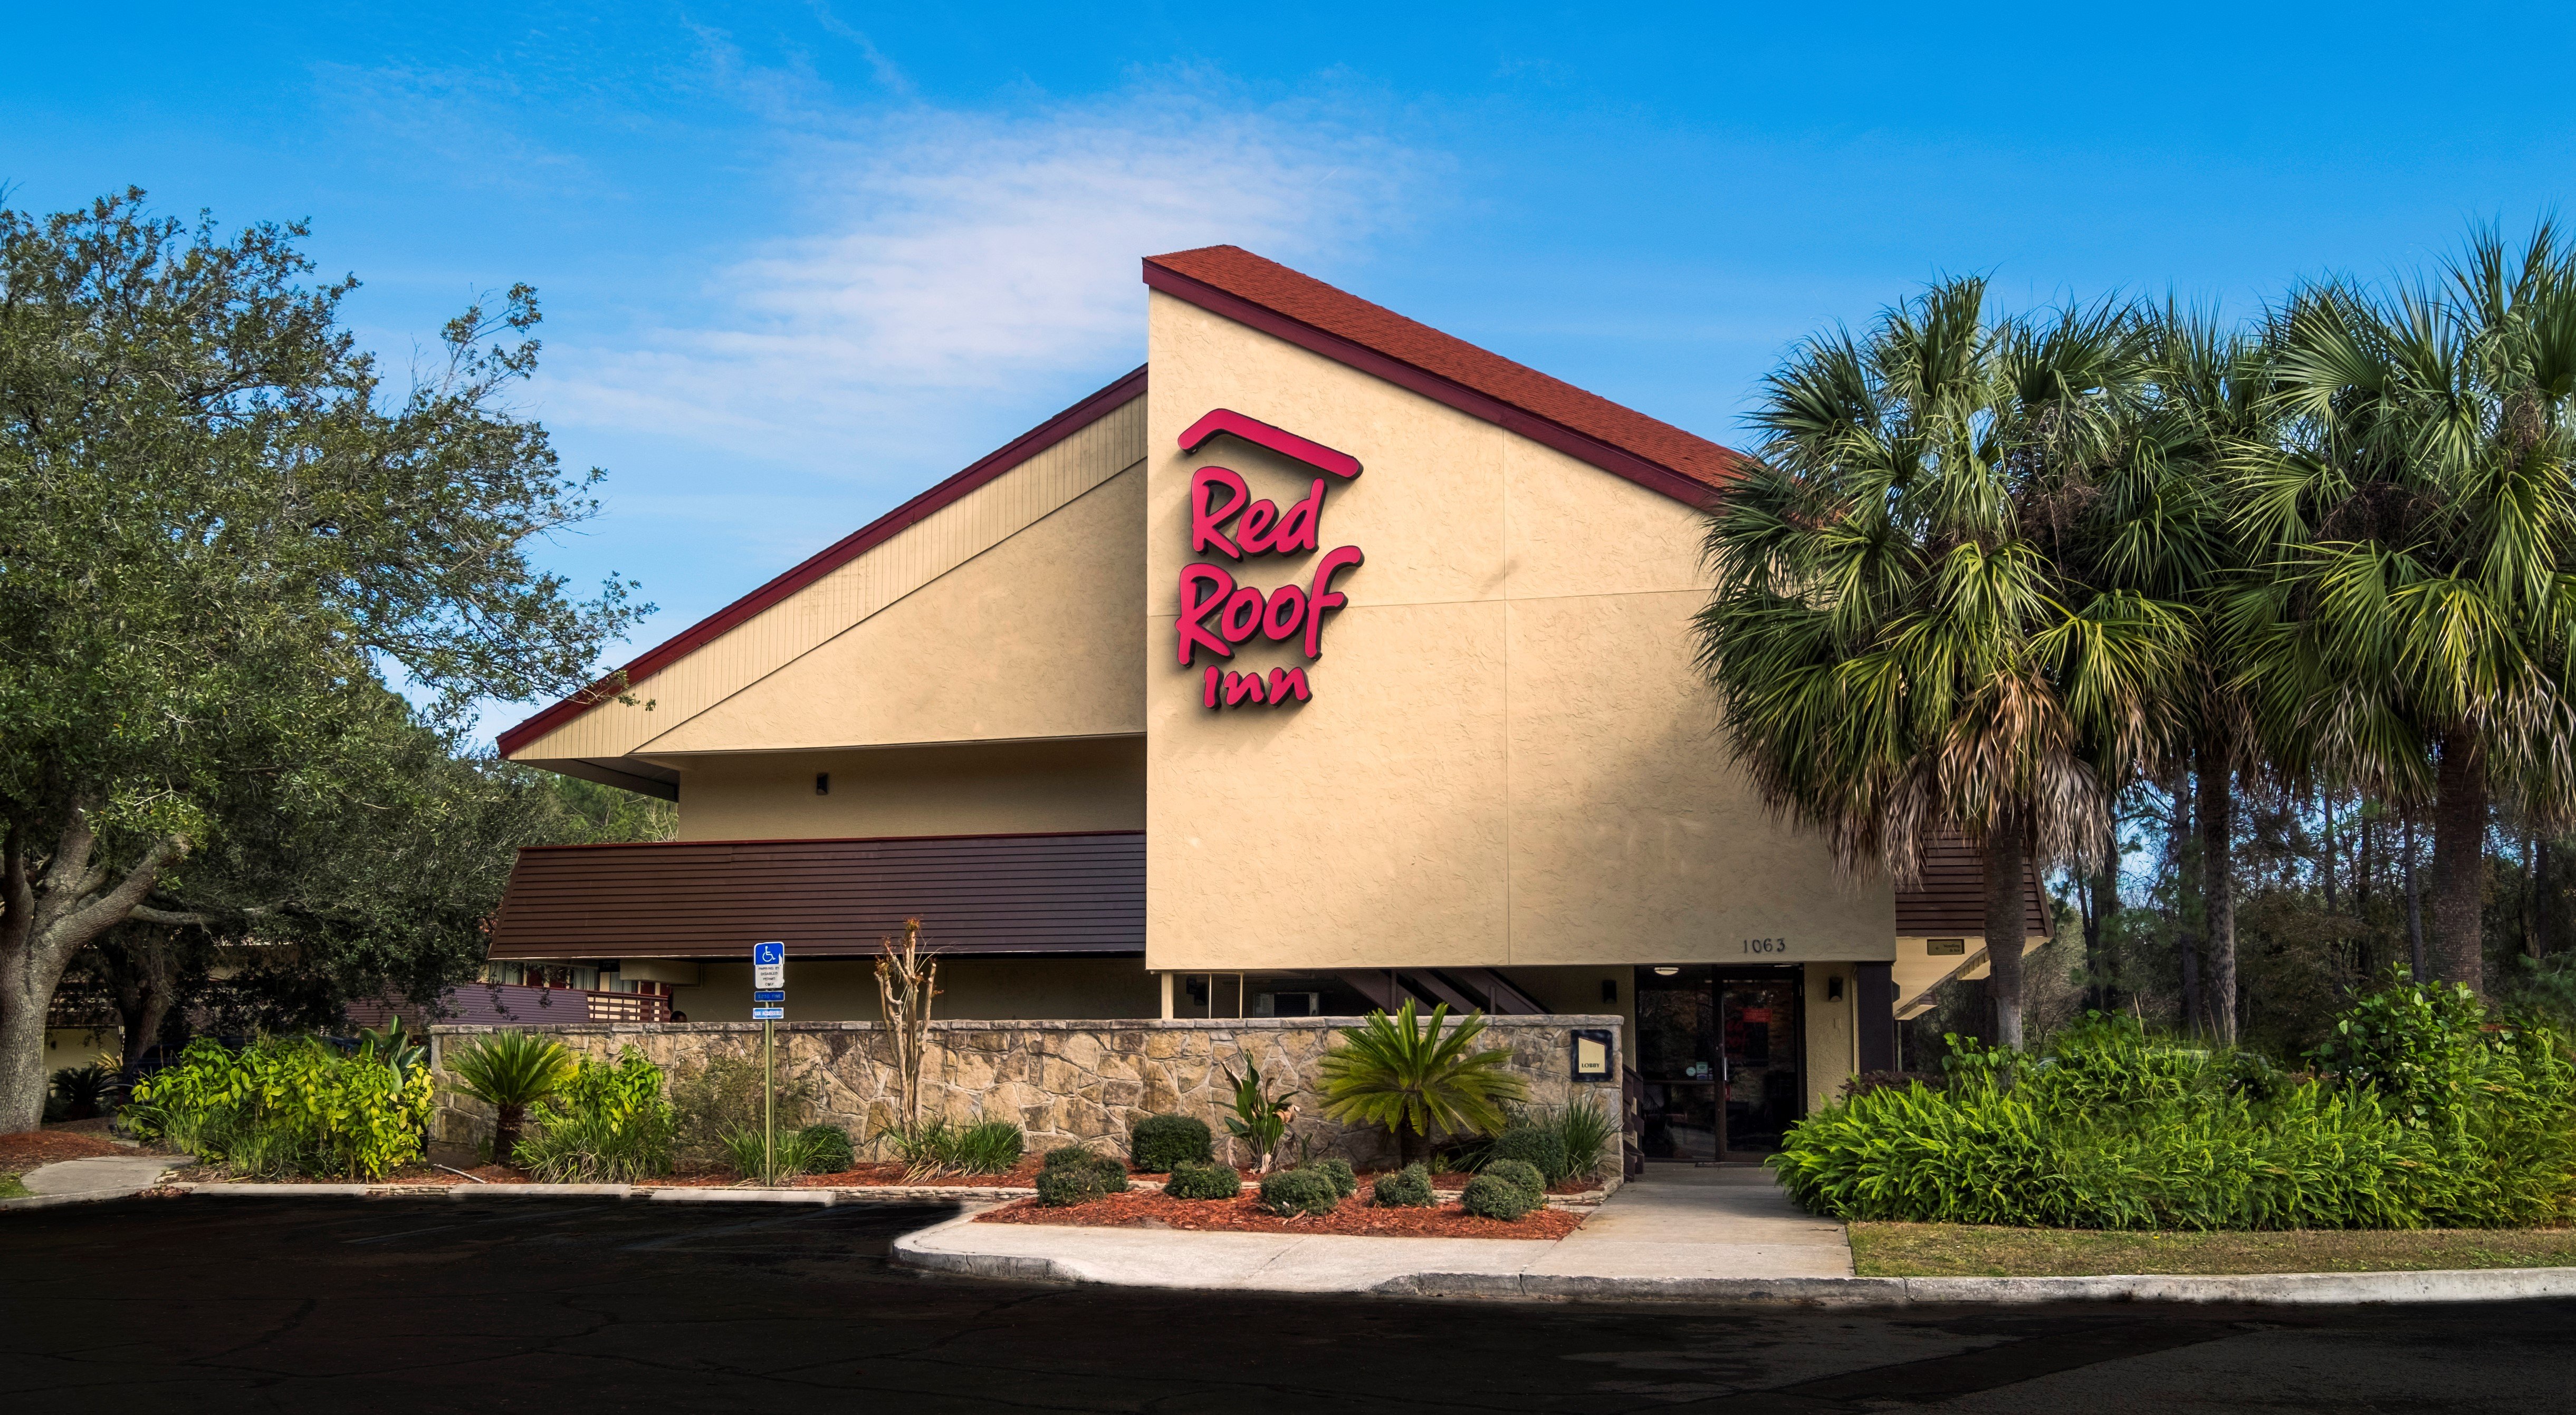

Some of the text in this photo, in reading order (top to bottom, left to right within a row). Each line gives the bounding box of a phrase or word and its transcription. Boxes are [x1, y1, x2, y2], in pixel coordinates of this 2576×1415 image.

[1191, 466, 1328, 562] Red
[1175, 545, 1365, 668] Roof
[1744, 938, 1785, 954] 1063
